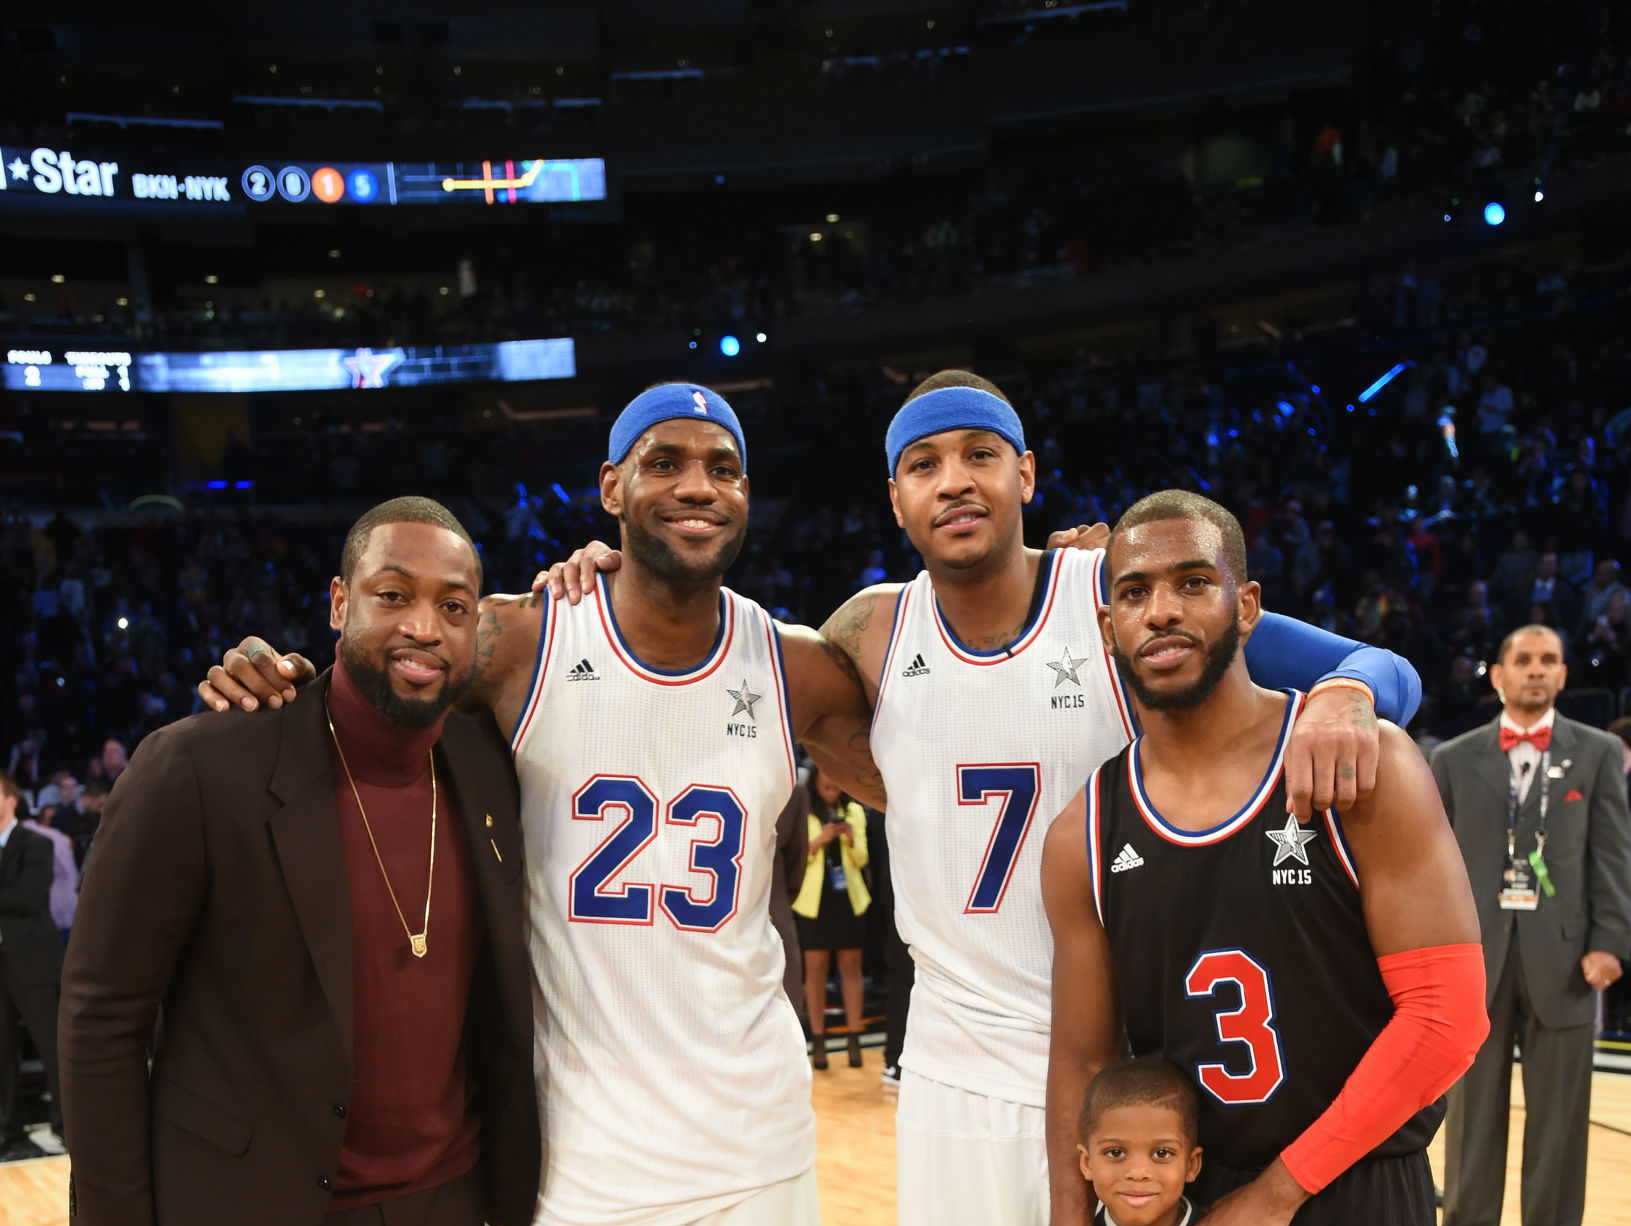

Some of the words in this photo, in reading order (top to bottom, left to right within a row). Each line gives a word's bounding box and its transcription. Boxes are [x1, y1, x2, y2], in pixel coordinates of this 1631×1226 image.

[31, 148, 118, 196] Star
[1051, 695, 1071, 709] NYC
[1073, 694, 1085, 708] 15
[726, 723, 746, 737] NYC
[747, 725, 757, 738] 15
[568, 773, 748, 933] 23
[956, 762, 1041, 914] 7
[1111, 857, 1144, 873] adidas
[1272, 869, 1296, 885] NYC
[1297, 869, 1312, 885] 15
[1183, 947, 1288, 1106] 3
